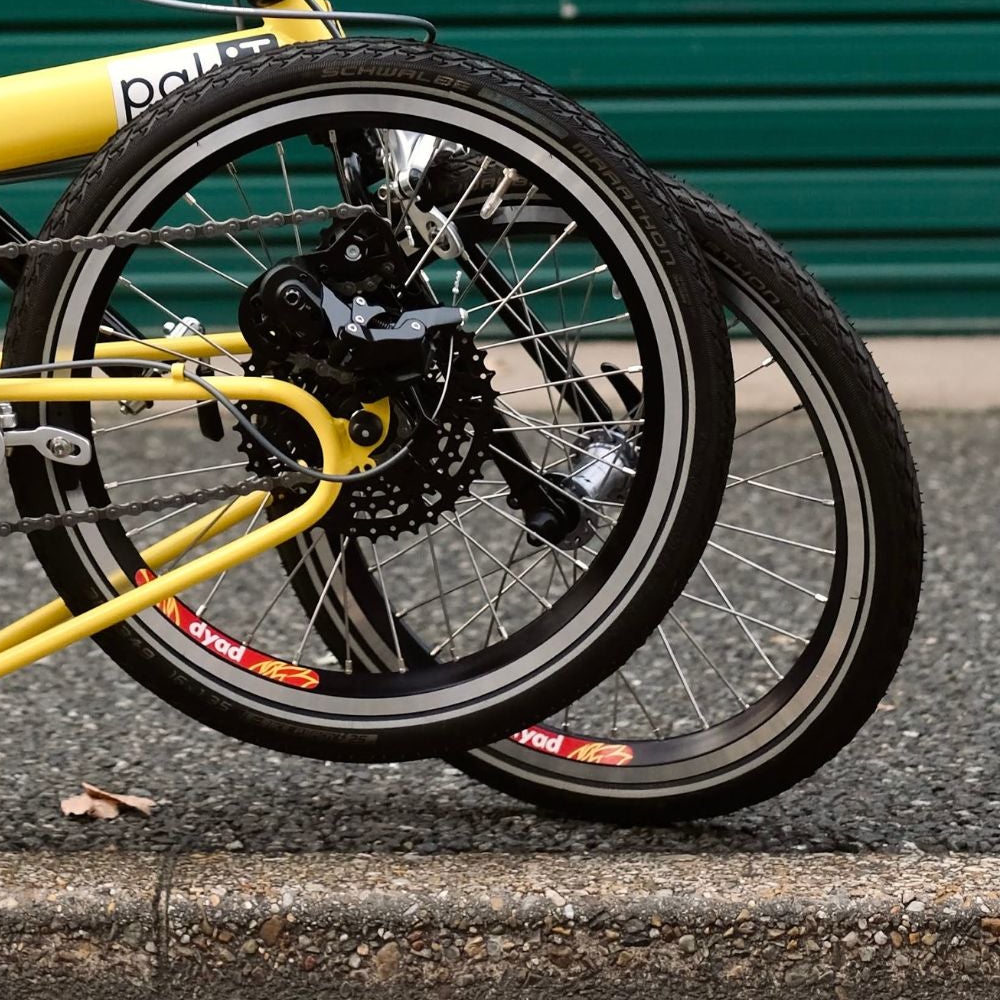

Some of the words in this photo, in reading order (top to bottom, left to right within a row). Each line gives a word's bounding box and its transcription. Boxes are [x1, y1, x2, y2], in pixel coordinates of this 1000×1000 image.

[121, 38, 270, 123] paT
[320, 65, 472, 92] SCHWALBE
[572, 142, 676, 267] MARATHON
[189, 621, 246, 663] dyad
[512, 728, 565, 754] yad
